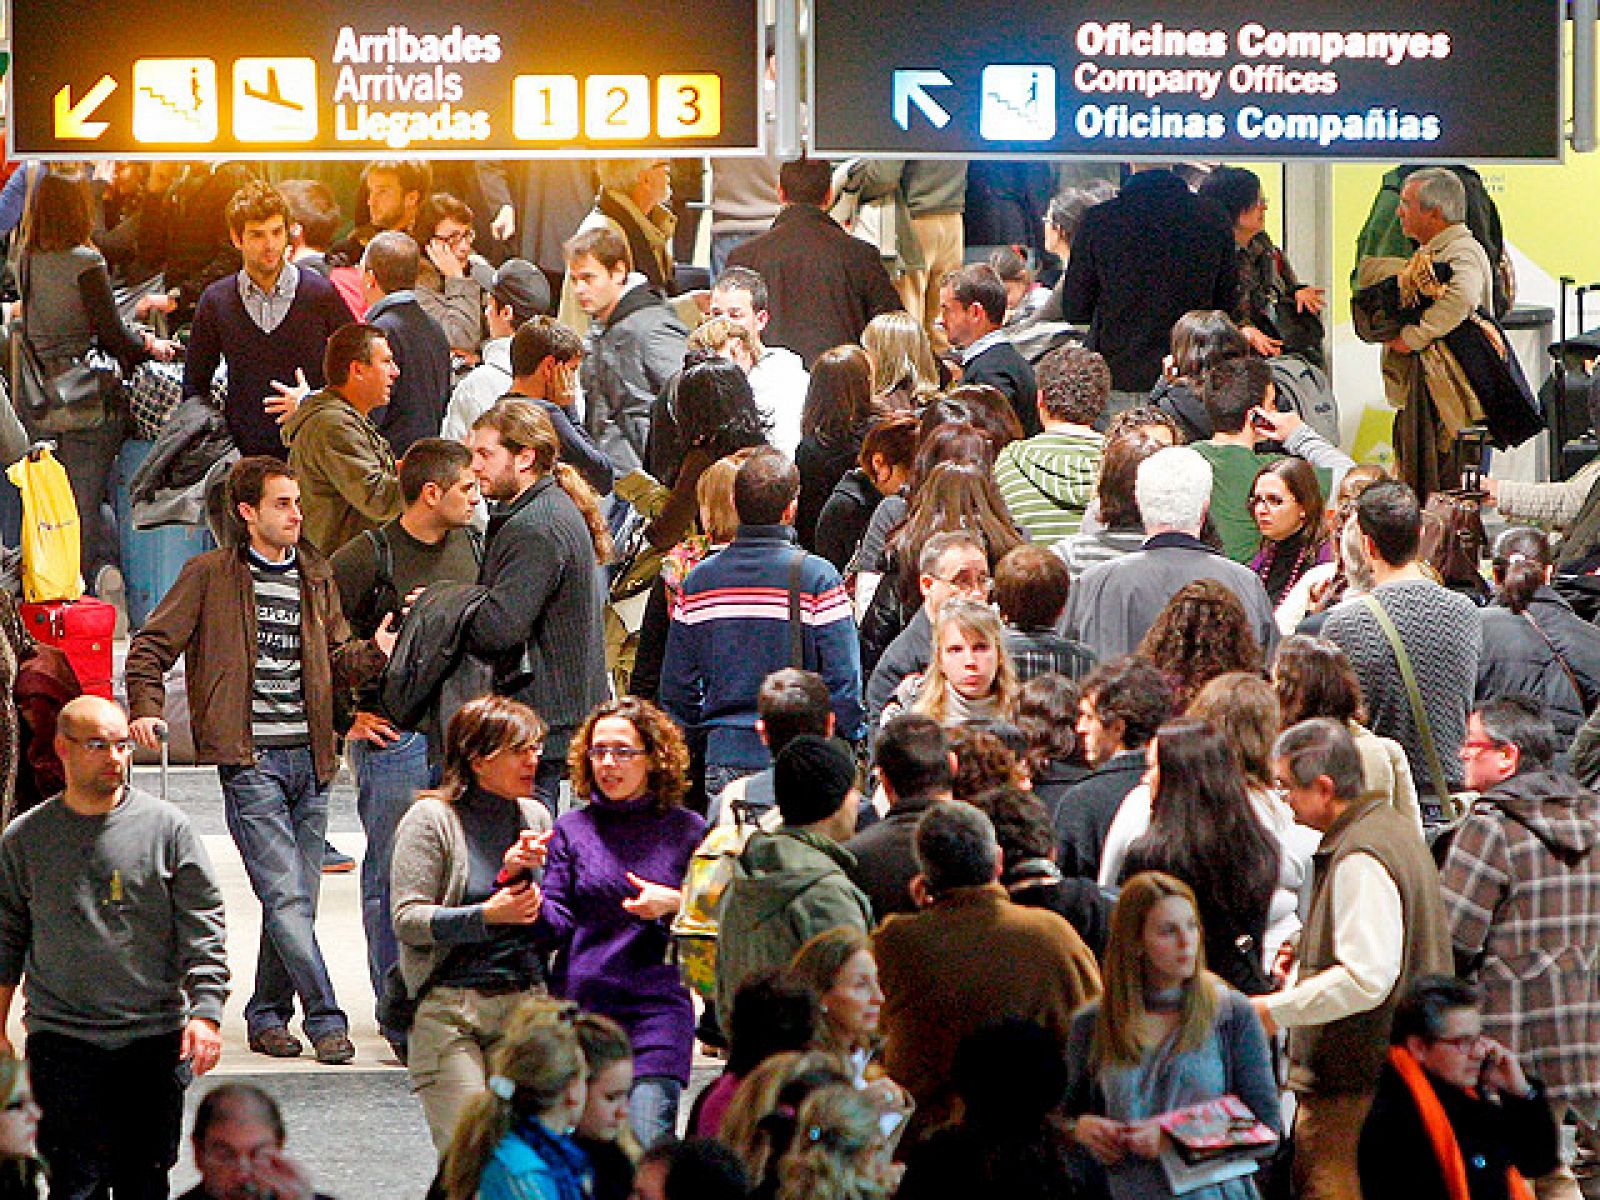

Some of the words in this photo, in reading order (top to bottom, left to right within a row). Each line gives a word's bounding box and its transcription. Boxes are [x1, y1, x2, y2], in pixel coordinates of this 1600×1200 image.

[332, 24, 502, 63] Arribades
[1076, 21, 1229, 57] Oficines
[1236, 21, 1452, 66] Companyes
[334, 64, 464, 103] Arrivals
[1073, 62, 1224, 100] Company
[1228, 64, 1340, 94] Offices
[335, 104, 491, 148] Llegadas
[538, 86, 555, 126] 1
[606, 86, 630, 126] 2
[676, 84, 702, 126] 3
[1075, 104, 1226, 139] Oficinas
[1235, 105, 1442, 146] Compañías
